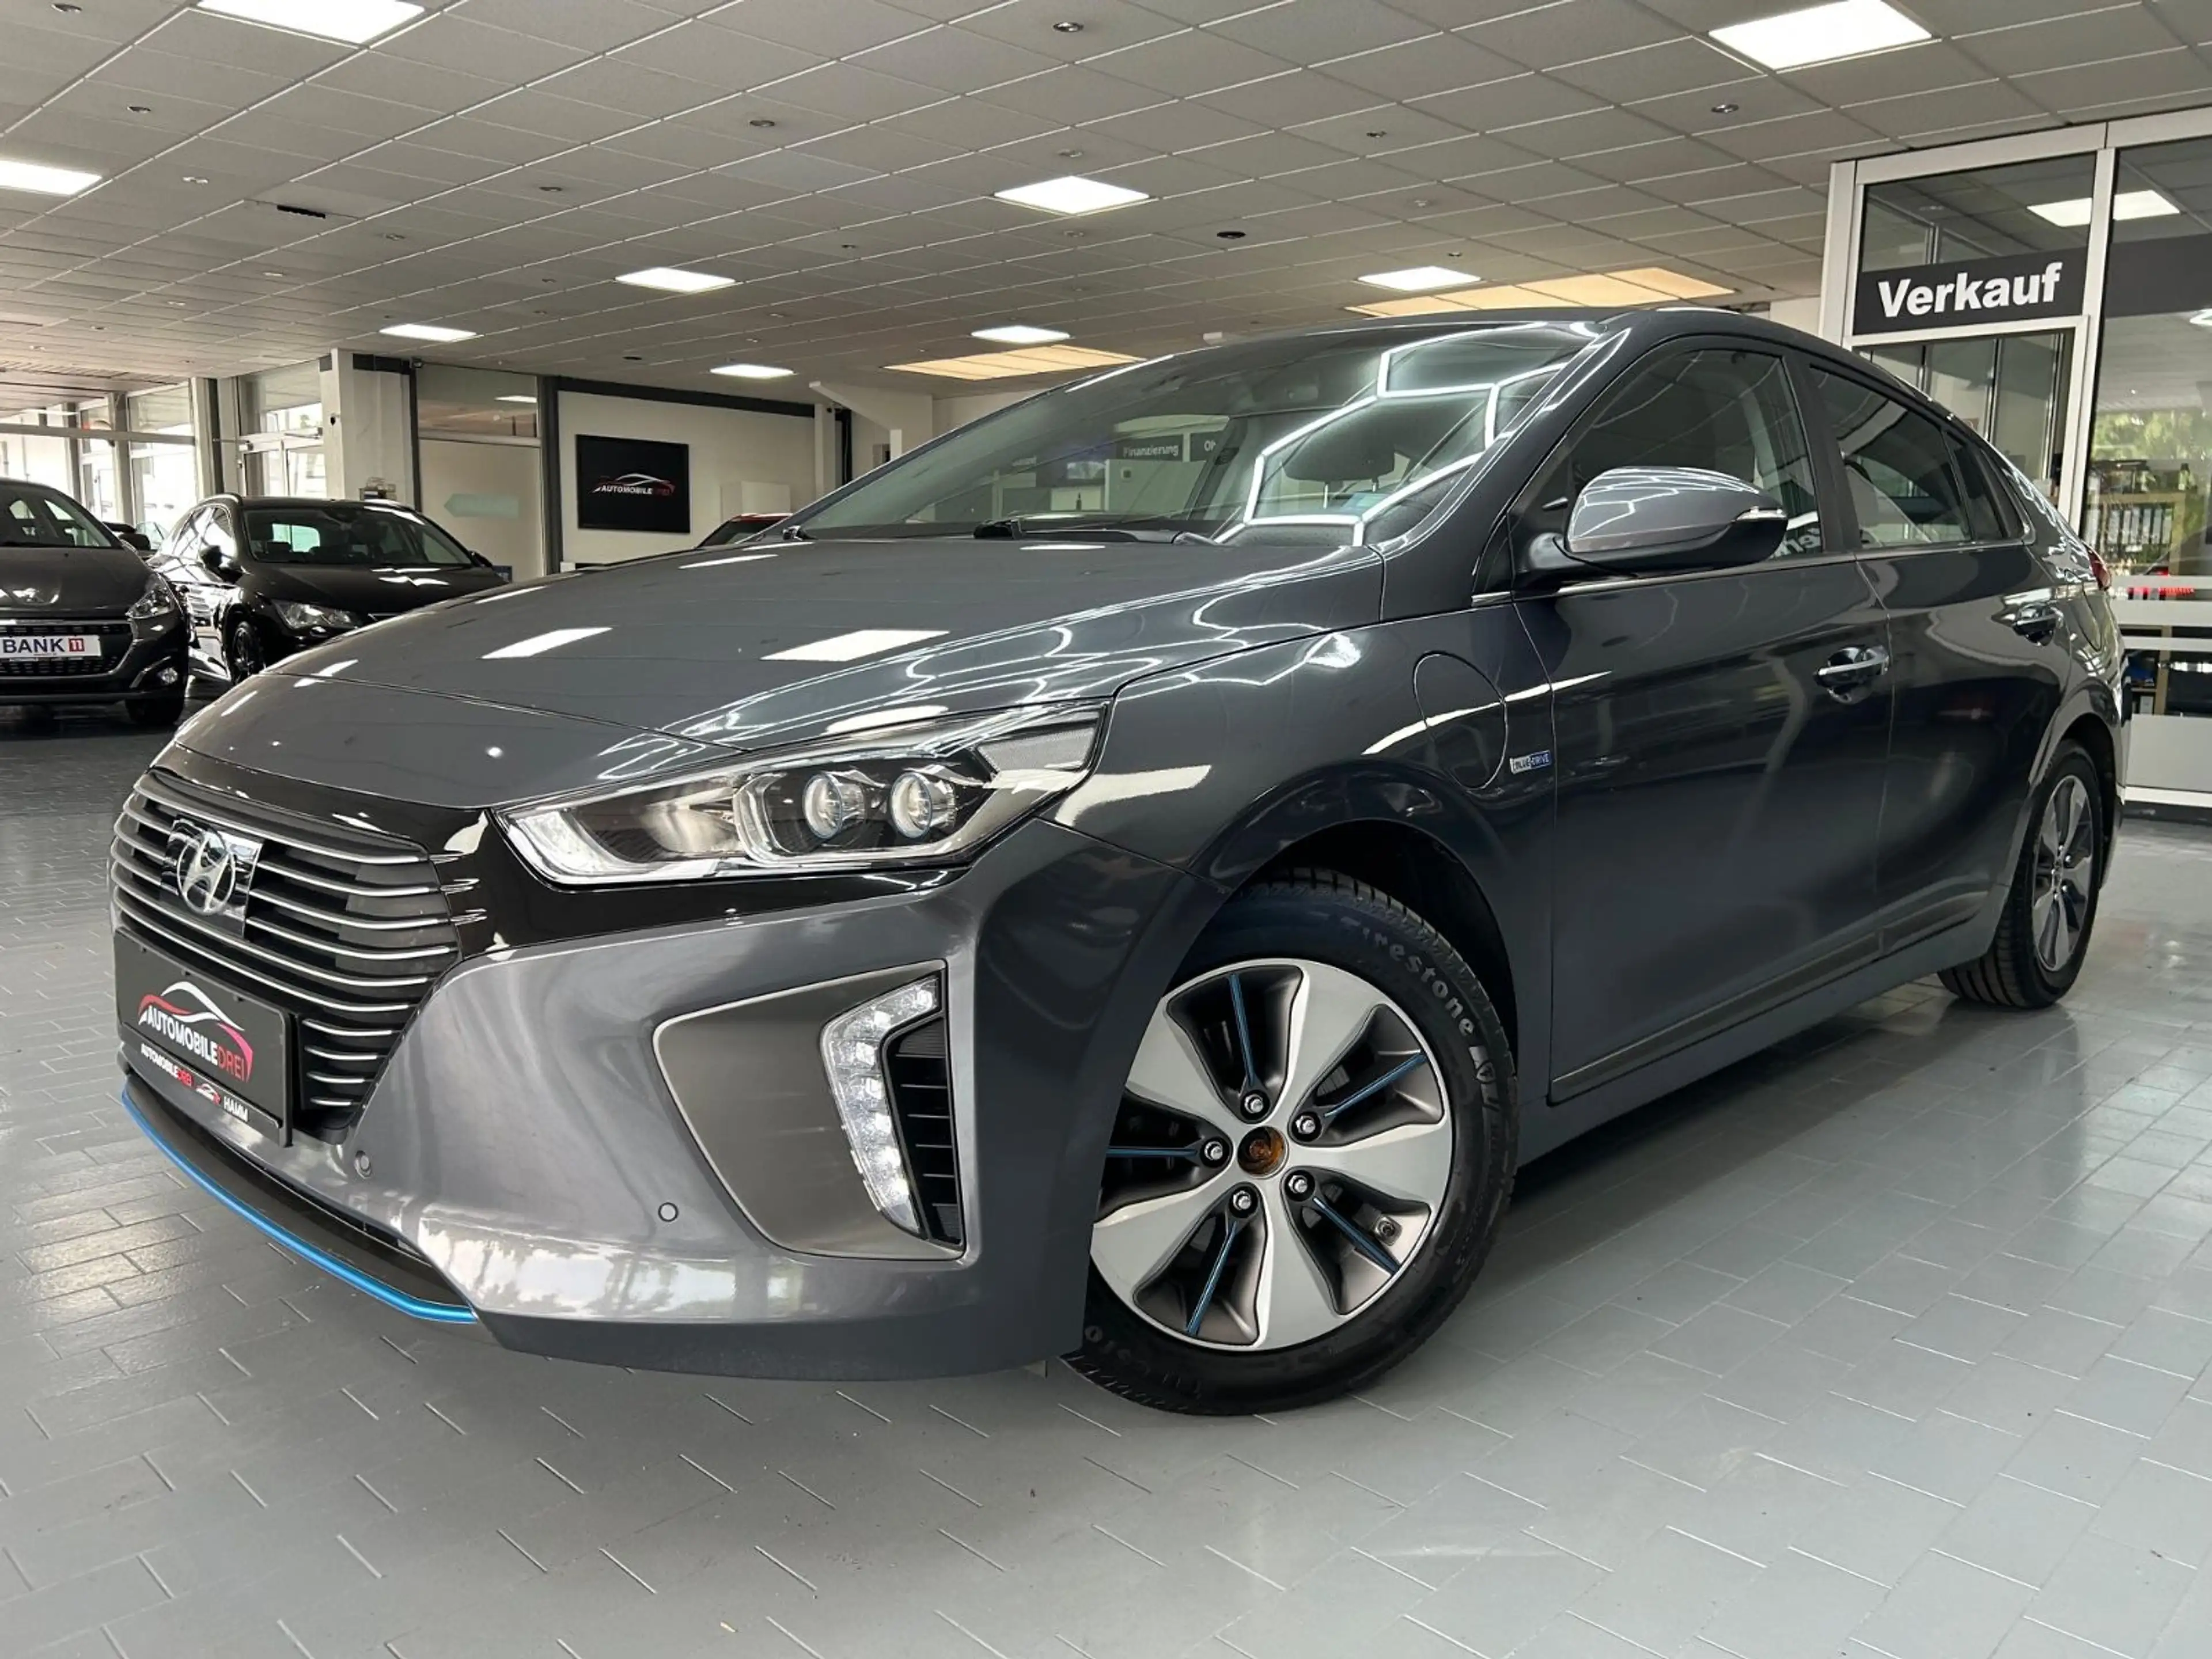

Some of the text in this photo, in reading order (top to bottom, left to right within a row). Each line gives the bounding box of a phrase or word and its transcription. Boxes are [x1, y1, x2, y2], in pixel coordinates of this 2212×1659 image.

[1878, 262, 2063, 317] Verkauf
[1123, 445, 1179, 458] Finanzierung
[3, 638, 65, 653] BANK
[147, 1005, 245, 1082] AUTOMOBILEDREI
[224, 1096, 248, 1122] HAMM
